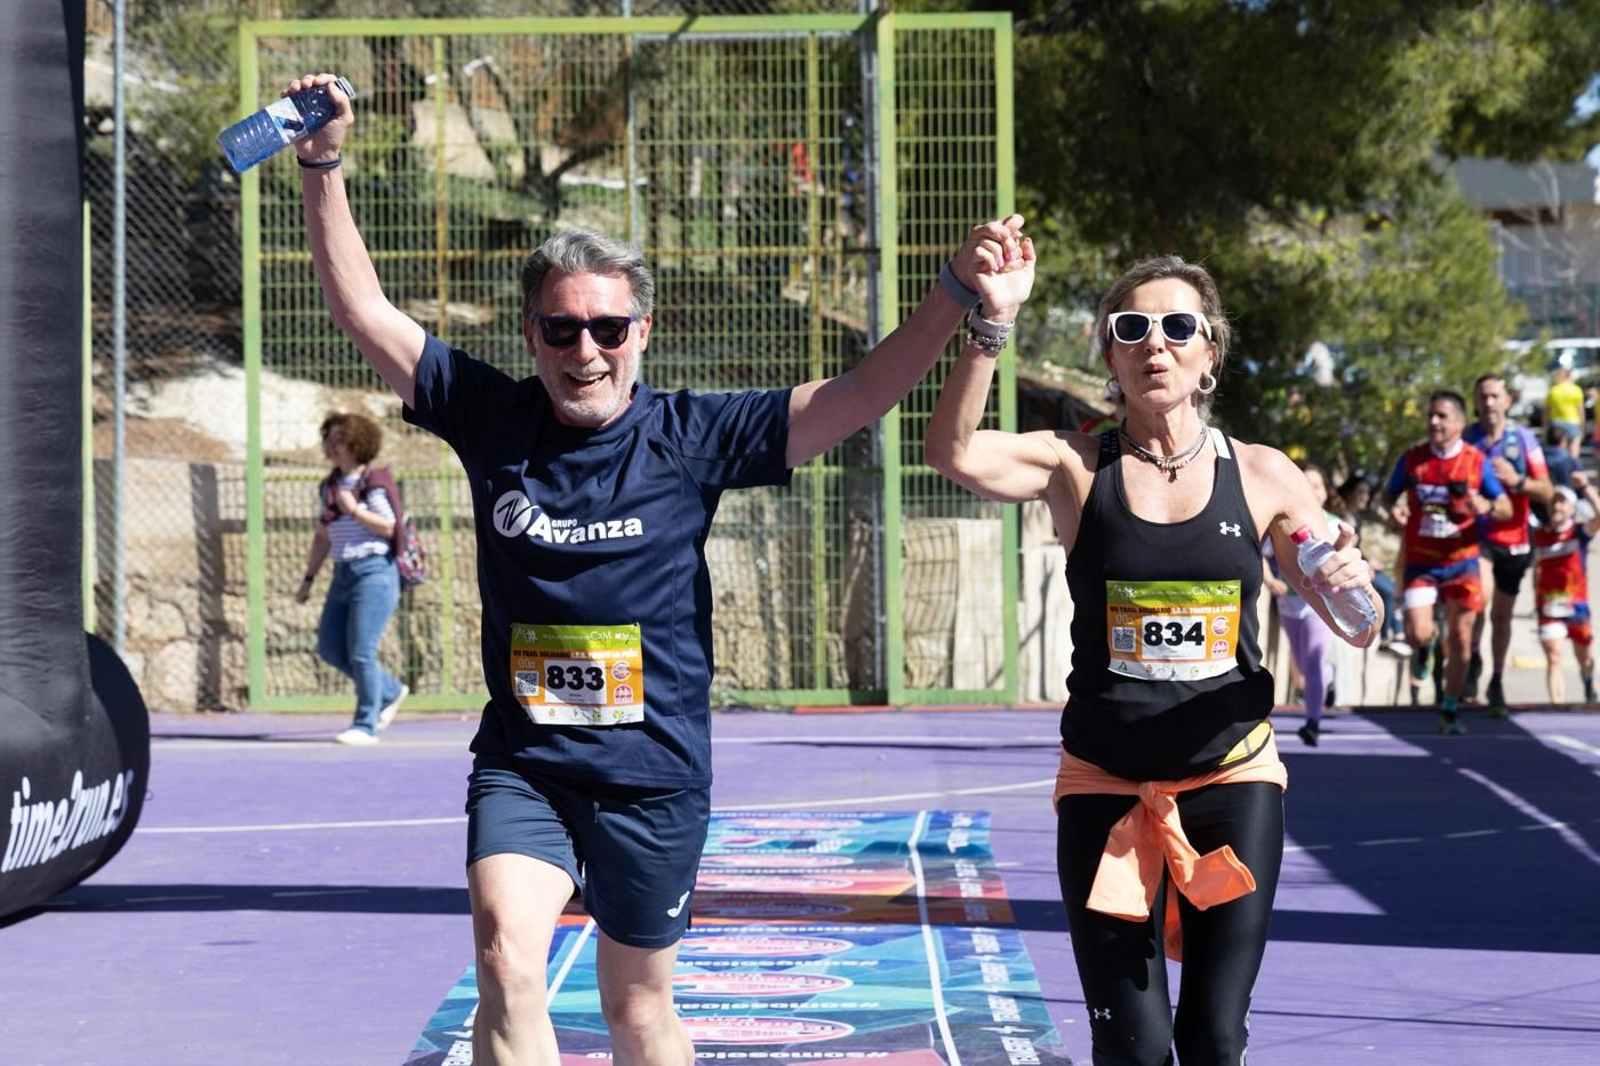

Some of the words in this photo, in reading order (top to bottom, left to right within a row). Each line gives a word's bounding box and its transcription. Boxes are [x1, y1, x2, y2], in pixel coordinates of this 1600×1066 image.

[526, 512, 643, 544] Avanza
[551, 519, 577, 528] GRUPO
[1143, 621, 1205, 647] 834
[546, 665, 605, 691] 833
